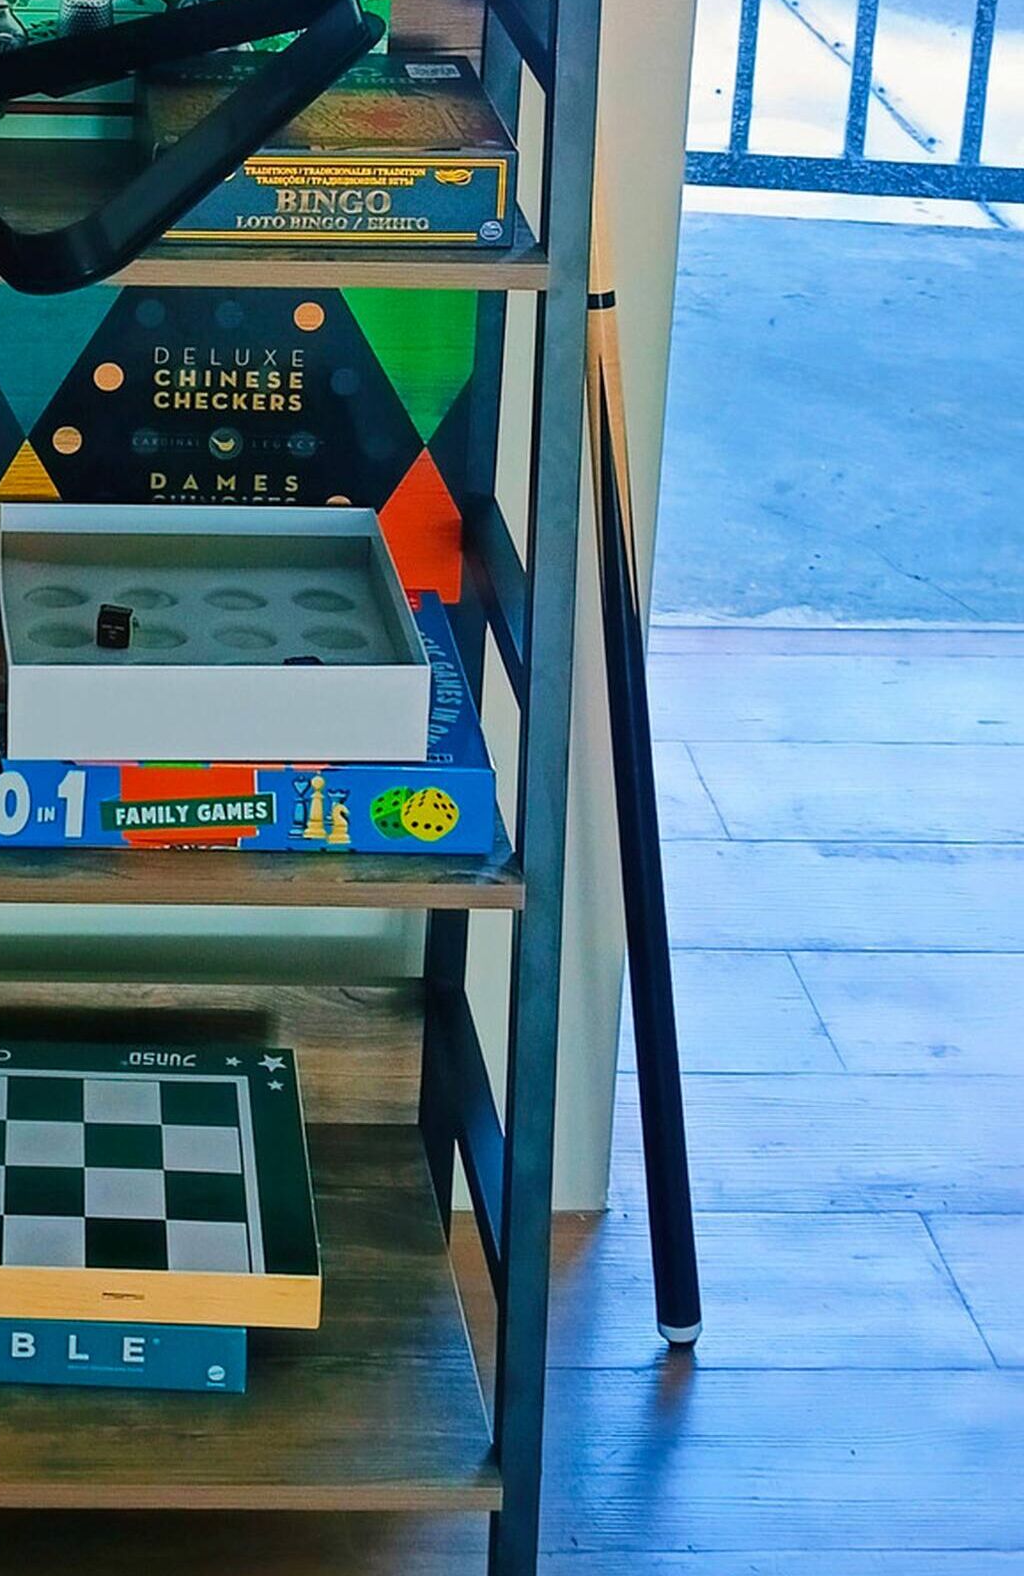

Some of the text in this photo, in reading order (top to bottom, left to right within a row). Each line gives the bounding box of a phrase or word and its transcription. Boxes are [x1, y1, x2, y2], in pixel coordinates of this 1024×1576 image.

[379, 168, 426, 177] TRADITION
[275, 189, 392, 215] BINGO
[235, 215, 286, 229] LOTO
[289, 216, 348, 230] BINGO
[367, 216, 430, 231] БИНГО
[153, 346, 305, 368] DELUXE
[153, 369, 304, 390] CHINESE
[153, 391, 303, 412] CHECKERS
[131, 435, 201, 448] CARDINAL
[149, 472, 300, 493] DAMES
[431, 661, 463, 705] GAMES
[430, 707, 461, 724] IN
[37, 805, 56, 823] IN
[57, 770, 88, 838] 1
[115, 799, 269, 827] FAMILY GAMES
